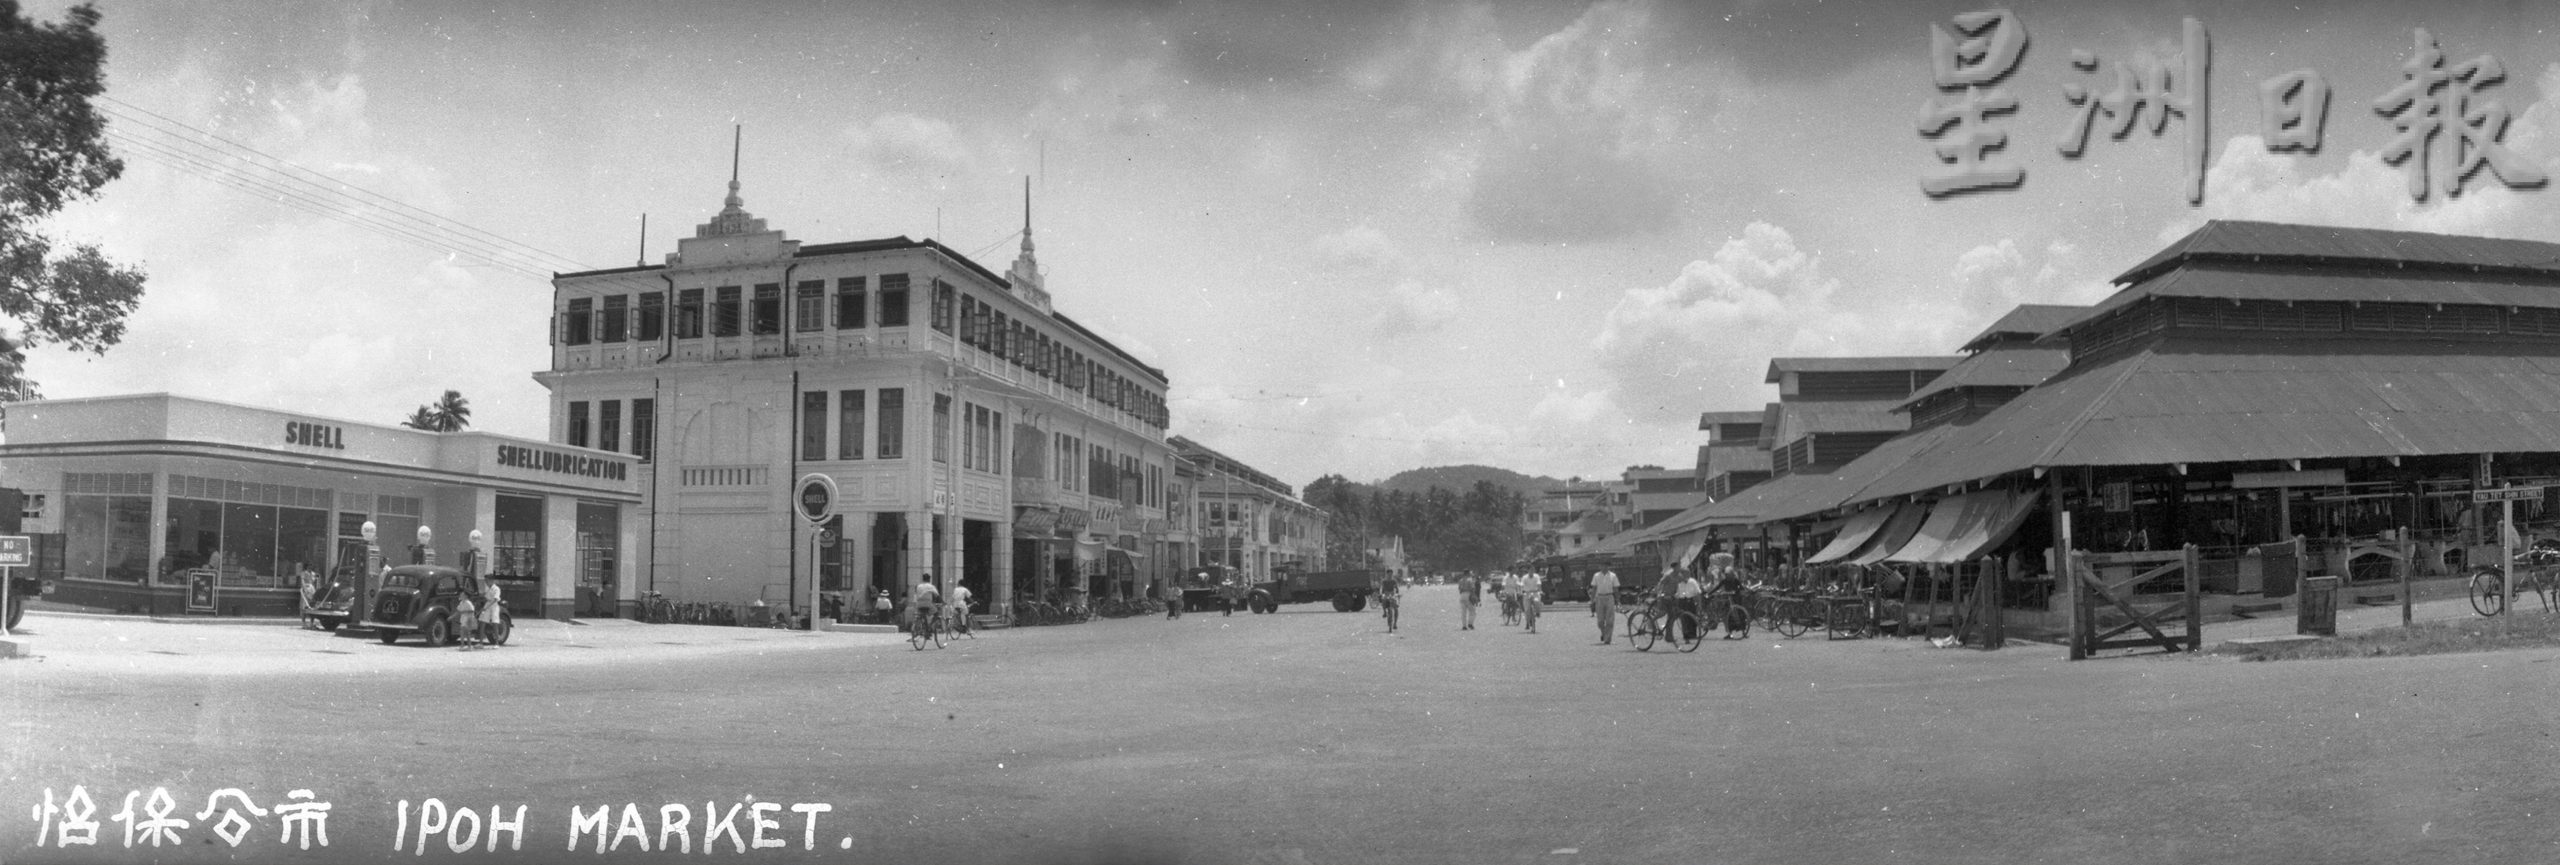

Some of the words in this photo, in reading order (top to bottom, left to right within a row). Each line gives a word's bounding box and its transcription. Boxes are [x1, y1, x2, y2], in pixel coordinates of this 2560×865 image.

[285, 421, 345, 450] SHELL
[497, 444, 626, 481] SHELLUBRICATION
[804, 494, 826, 504] SHELL
[3, 540, 14, 550] NO
